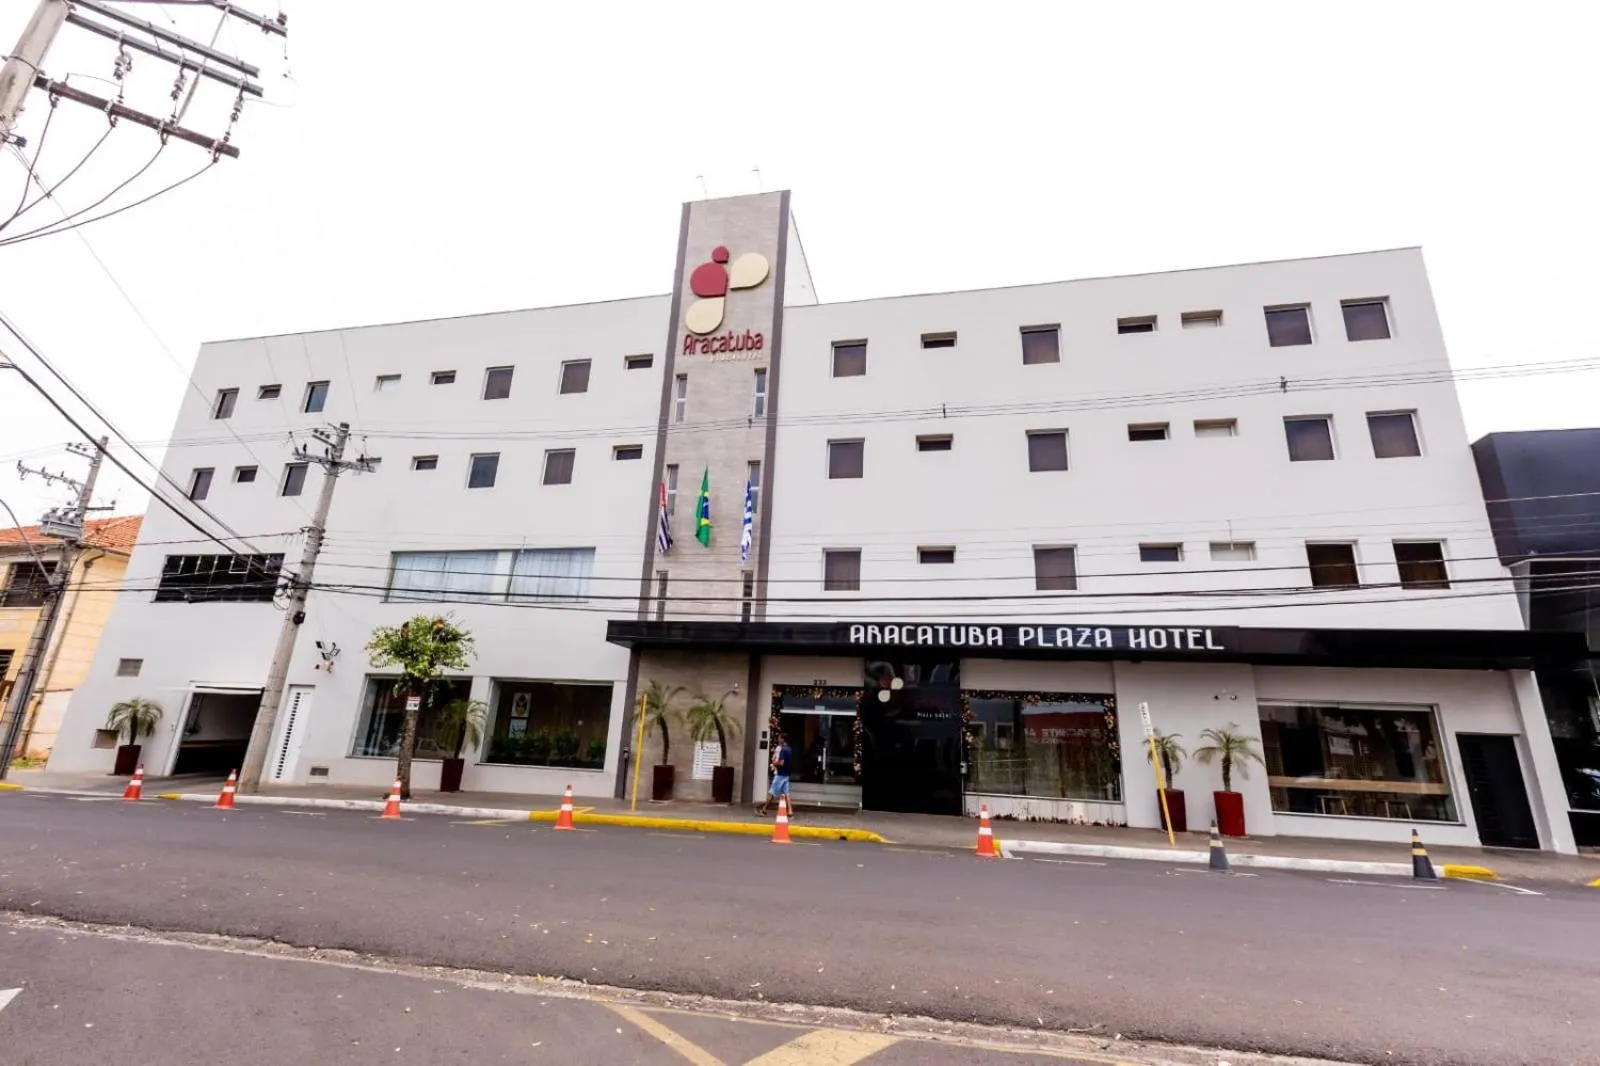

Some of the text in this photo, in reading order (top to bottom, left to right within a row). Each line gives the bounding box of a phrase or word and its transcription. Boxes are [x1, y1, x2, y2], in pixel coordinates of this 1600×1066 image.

[683, 329, 763, 355] Araçatuba
[1018, 626, 1113, 648] PLAZA
[1128, 628, 1225, 650] HOTEL
